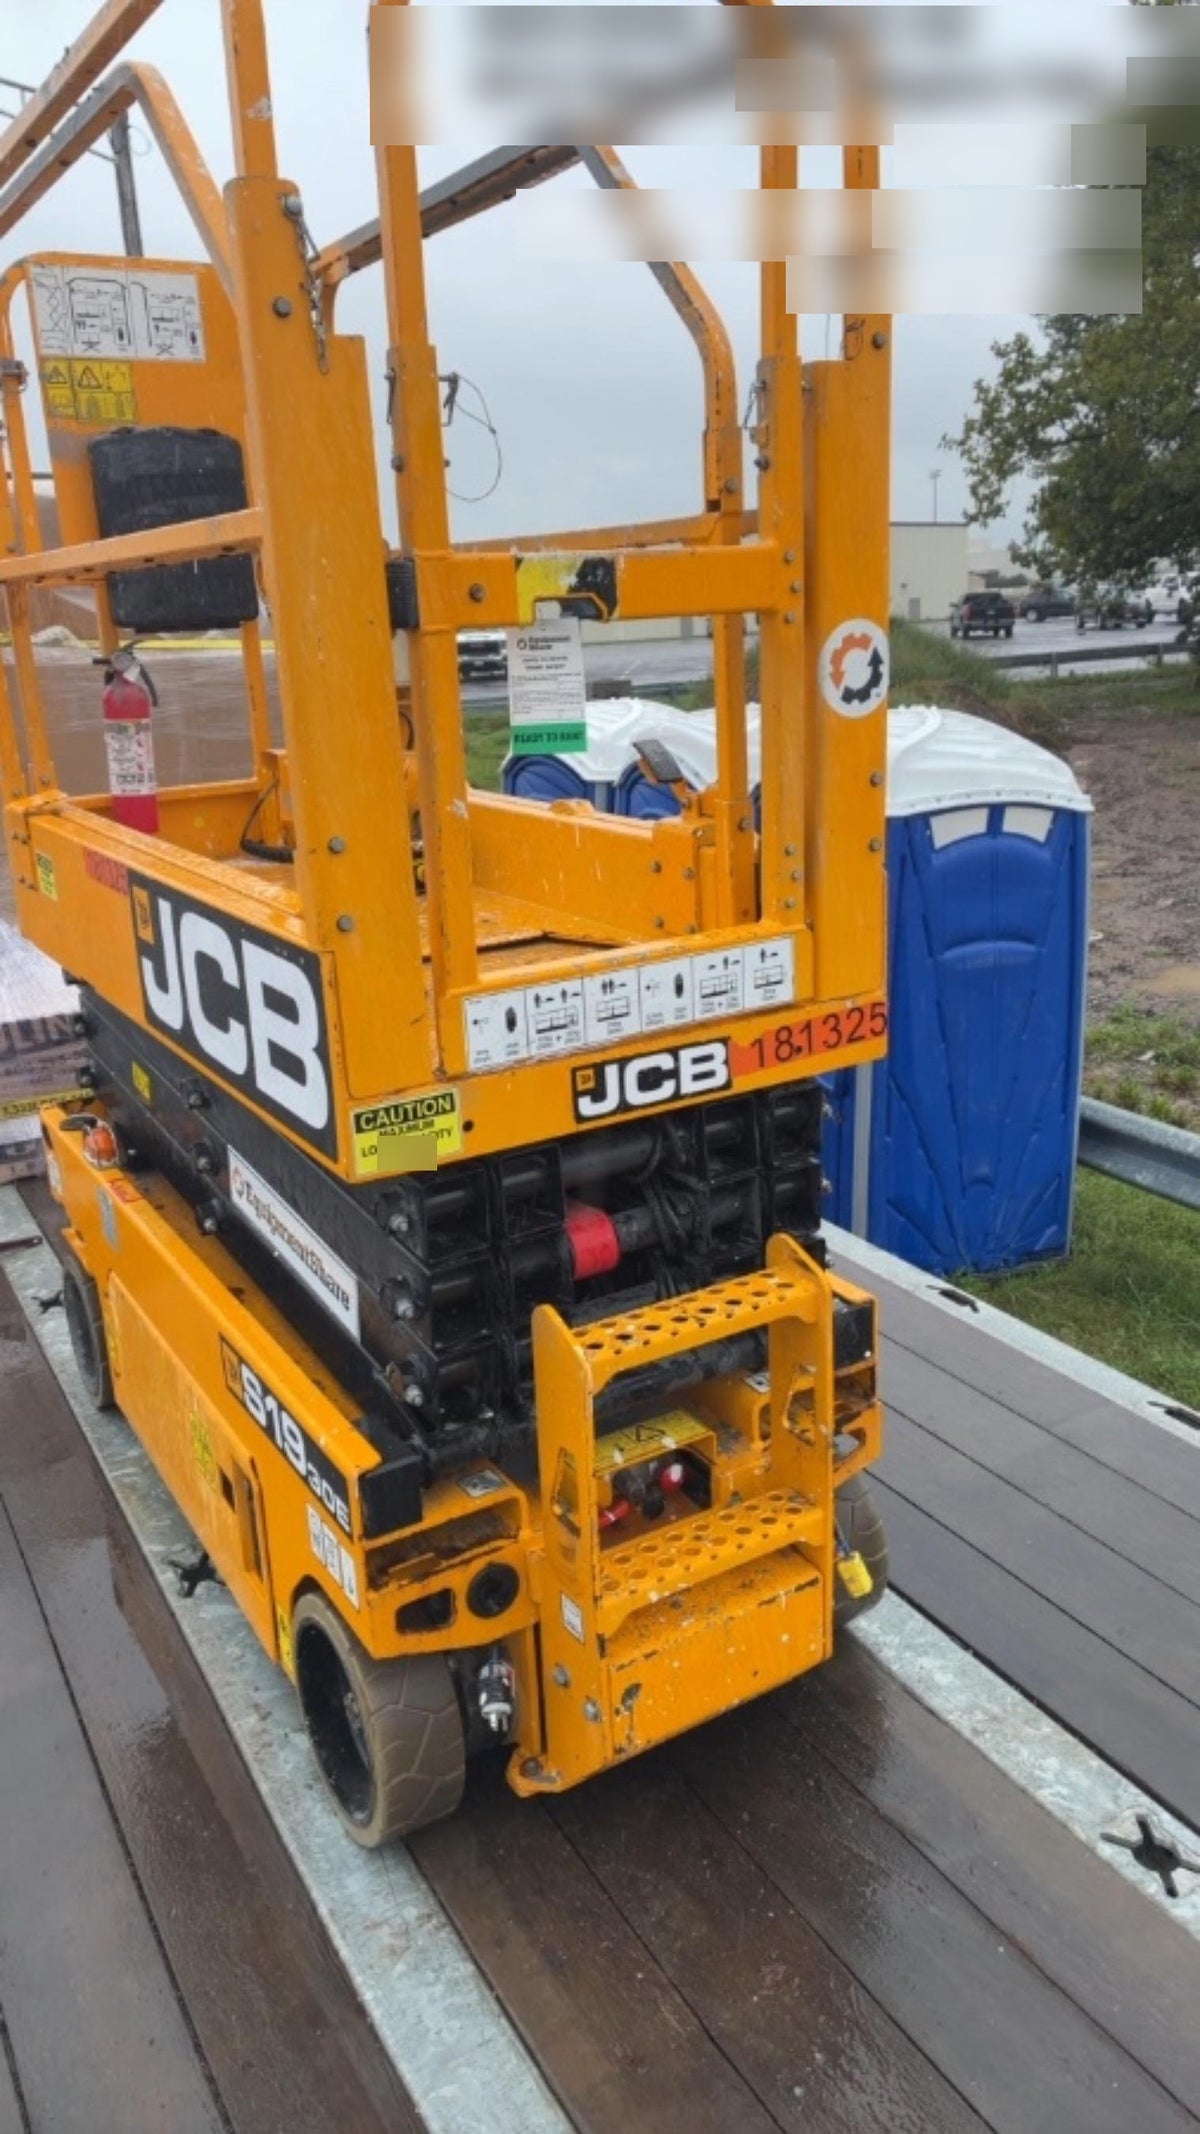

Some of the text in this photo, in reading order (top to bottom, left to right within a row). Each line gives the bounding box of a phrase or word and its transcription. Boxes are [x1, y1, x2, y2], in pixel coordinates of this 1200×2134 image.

[141, 897, 329, 1130] JCB
[360, 1095, 452, 1130] CAUTION
[577, 1040, 729, 1118] JCB
